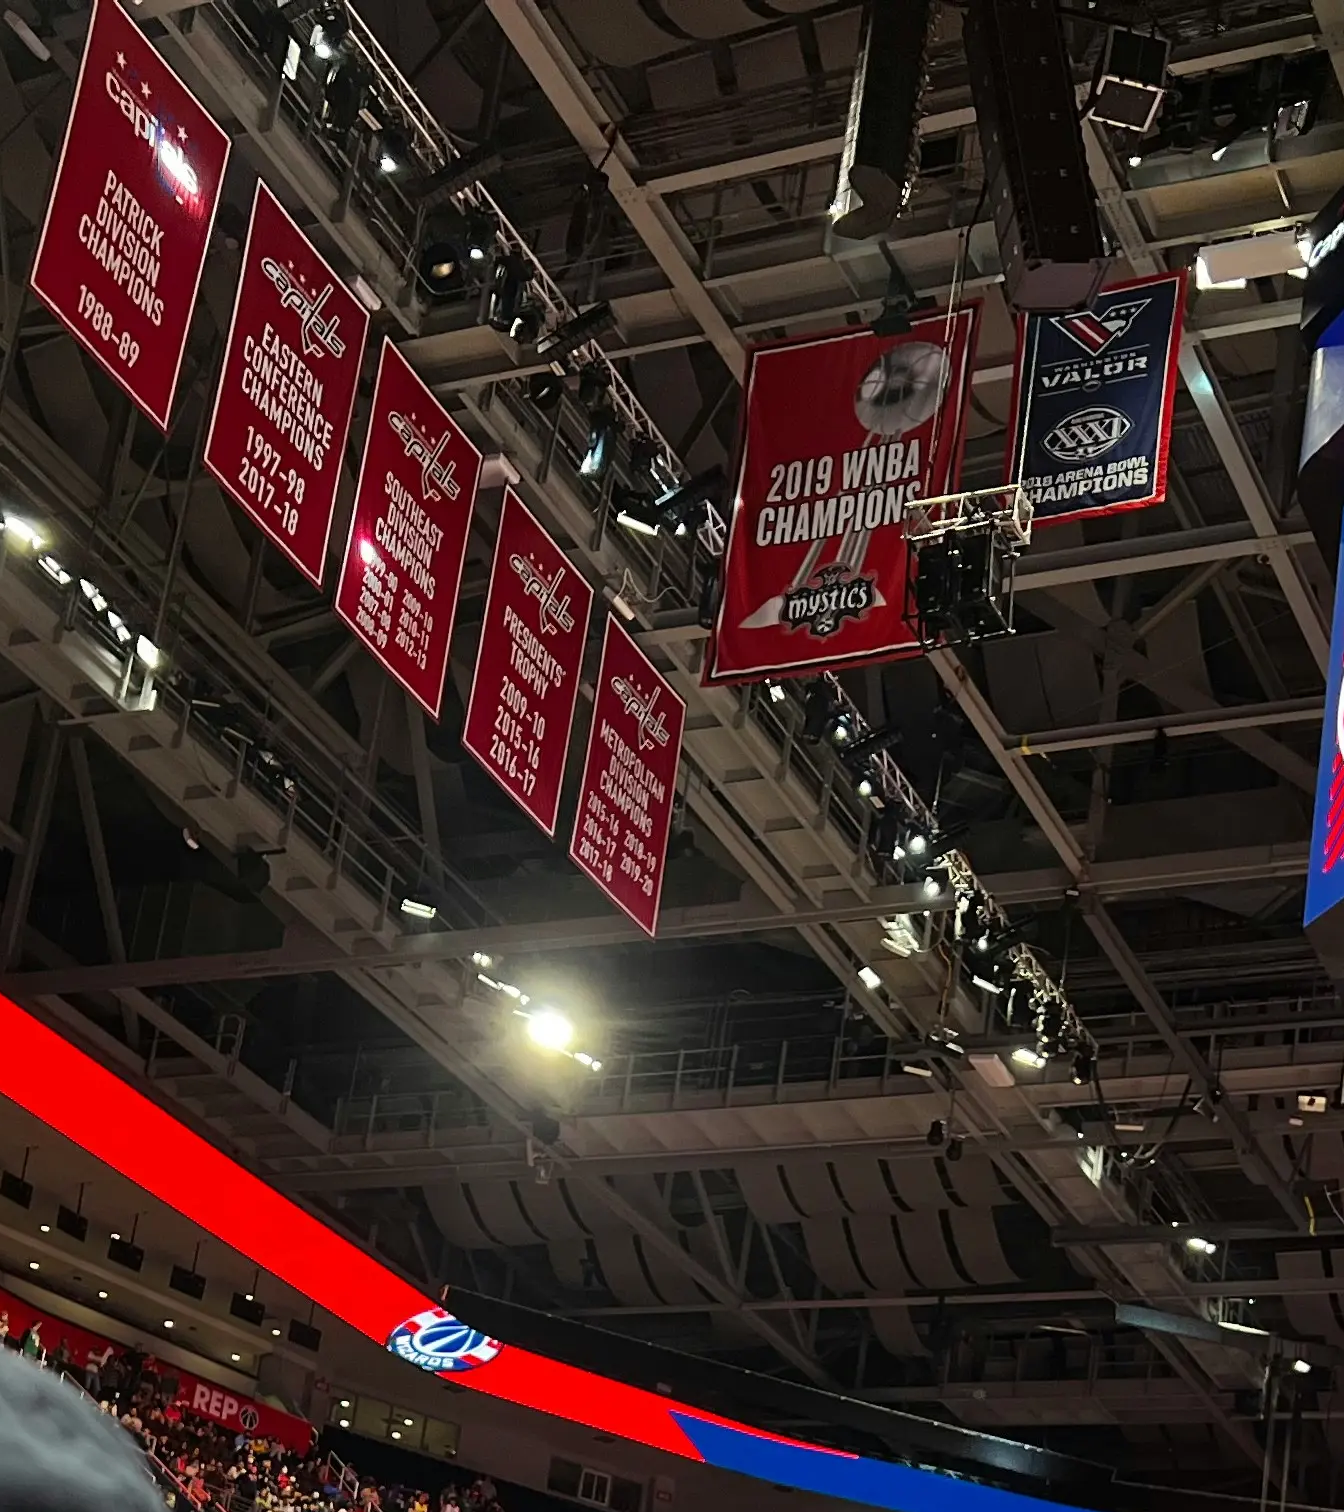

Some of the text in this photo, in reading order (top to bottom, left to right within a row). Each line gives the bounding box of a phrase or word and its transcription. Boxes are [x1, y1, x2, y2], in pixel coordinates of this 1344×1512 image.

[95, 195, 161, 289] DIVISION
[104, 169, 165, 257] PATRICK
[78, 213, 165, 327] CHAMPIONS
[77, 284, 140, 368] 1988-89
[243, 334, 333, 451] CONFERENCE
[263, 322, 324, 408] EASTERN
[1040, 355, 1148, 389] VALOR
[241, 366, 324, 473] CHAMPIONS
[238, 457, 298, 537] 2017-18
[246, 425, 306, 505] 1997-98
[765, 438, 922, 504] 2019 WNBA
[1055, 465, 1104, 485] ARENA
[1106, 455, 1150, 475] BOWL
[384, 471, 444, 552] SOUTHEAST
[387, 502, 433, 570] DIVISION
[375, 517, 436, 600] CHAMPIONS
[787, 582, 870, 622] mystics
[509, 639, 549, 702] TROPHY
[493, 704, 541, 769] 2015-16
[499, 676, 546, 741] 2009-10
[489, 733, 537, 798] 2016-17
[598, 718, 666, 805] METROPOLITAN
[608, 753, 651, 813] DIVISION
[599, 769, 653, 838] CHAMPIONS
[192, 1383, 239, 1421] REP
